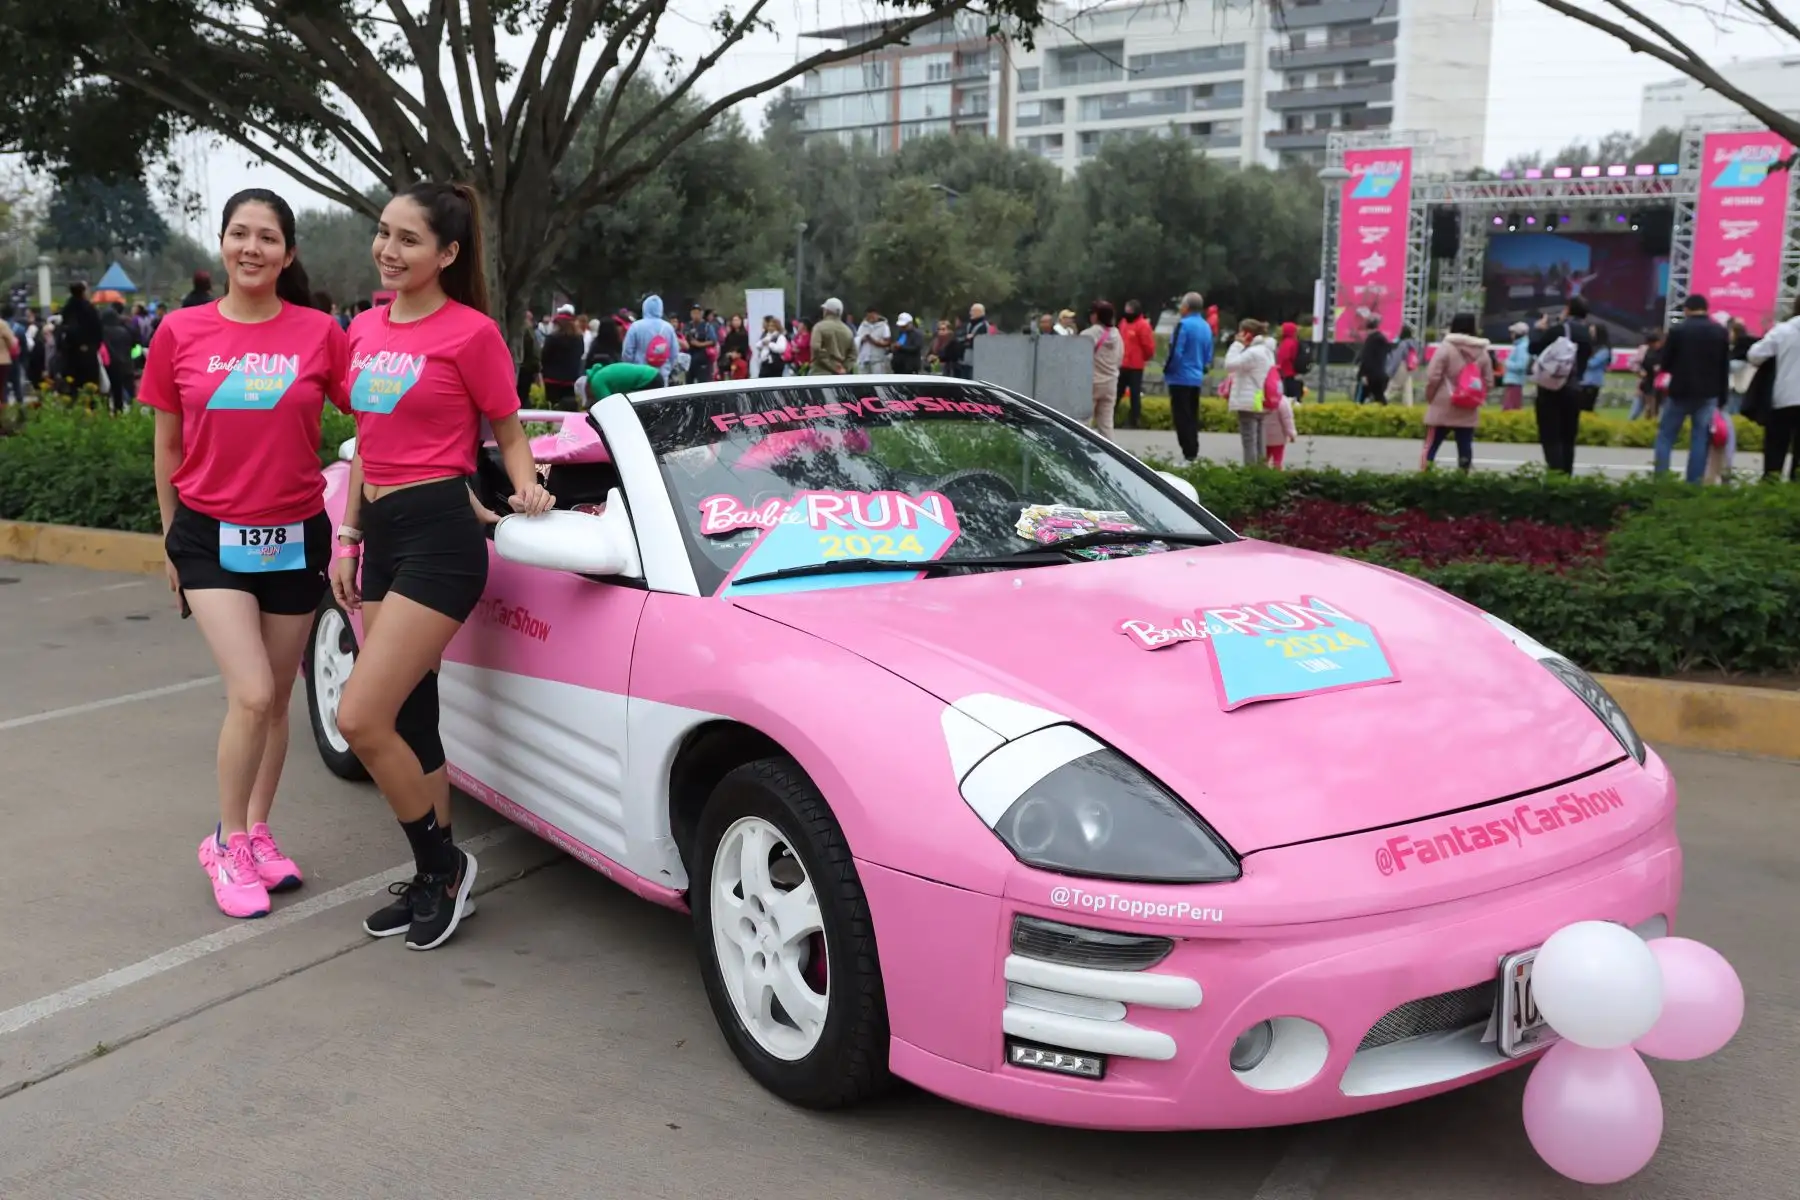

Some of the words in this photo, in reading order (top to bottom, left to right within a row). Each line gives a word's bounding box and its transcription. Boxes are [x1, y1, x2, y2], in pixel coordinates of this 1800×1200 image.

[207, 355, 247, 373] Barbie
[243, 353, 300, 376] RUN
[371, 351, 427, 378] RUN
[245, 378, 284, 391] 2024
[368, 378, 402, 395] 2024
[711, 396, 1004, 432] FantasyCarShow
[705, 497, 808, 531] Barbie
[807, 493, 946, 530] RUN
[239, 527, 287, 546] 1378
[818, 535, 925, 558] 2024
[1121, 618, 1233, 646] Barbie
[1205, 597, 1352, 634] RUN
[1266, 631, 1370, 658] 2024
[1375, 786, 1625, 877] @FantasyCarShow
[1050, 886, 1223, 922] @TopTopperPeru
